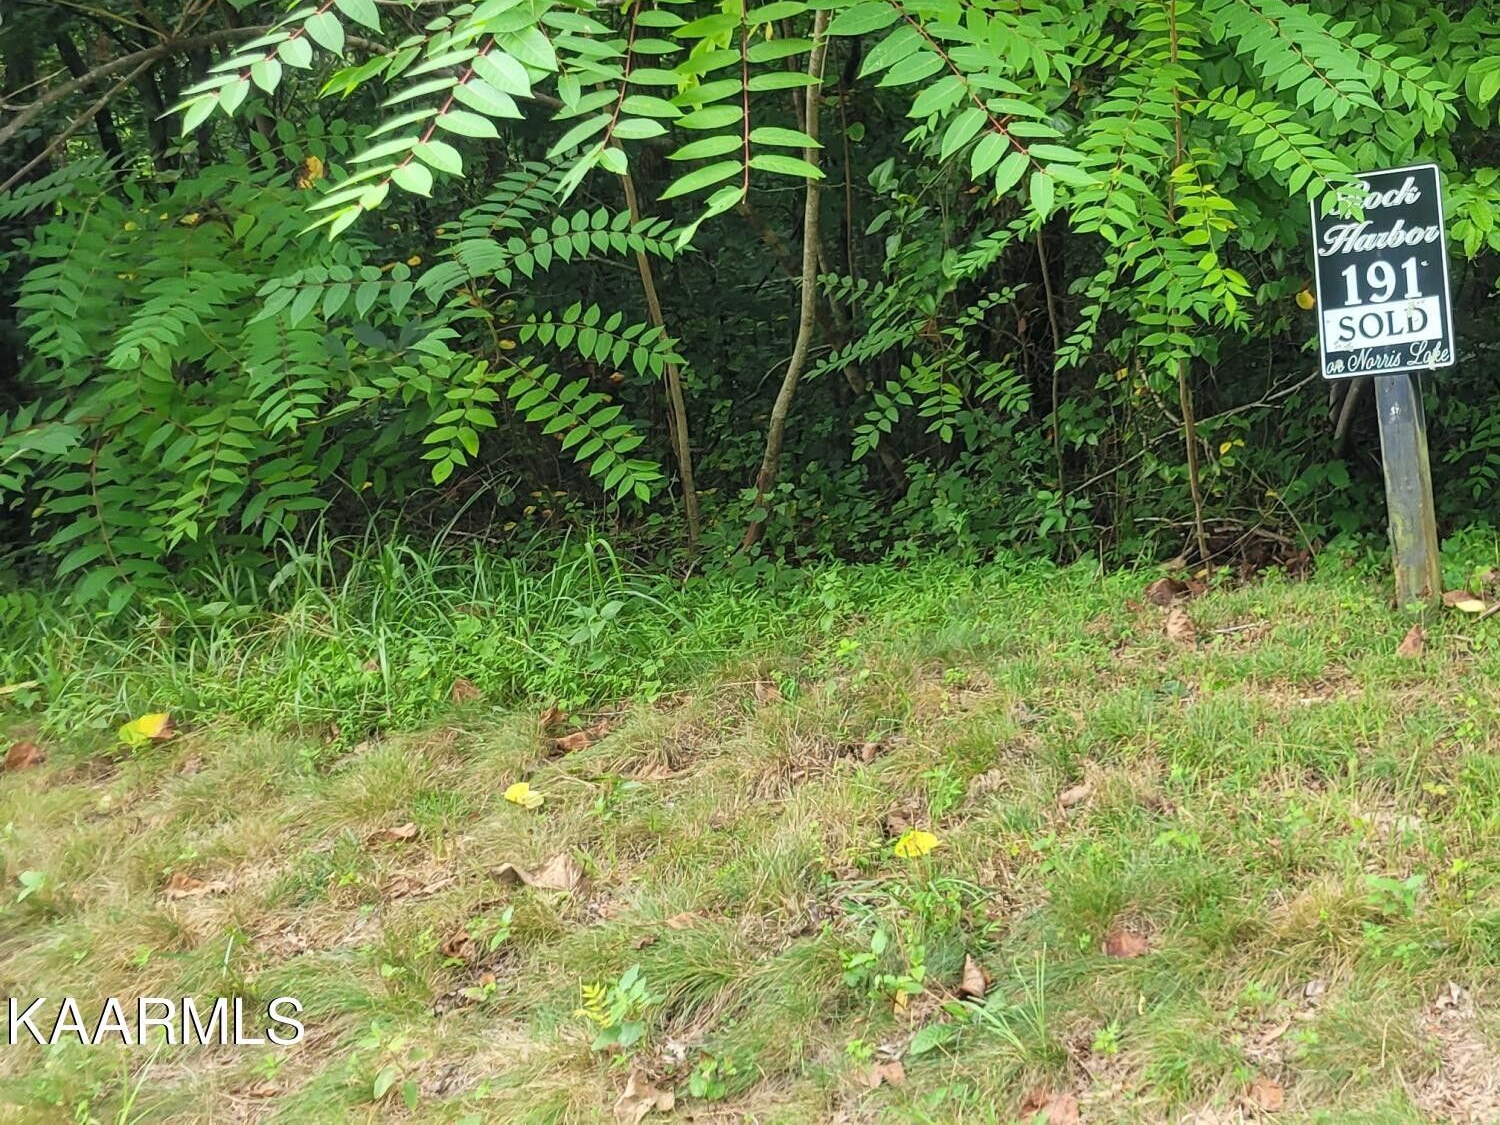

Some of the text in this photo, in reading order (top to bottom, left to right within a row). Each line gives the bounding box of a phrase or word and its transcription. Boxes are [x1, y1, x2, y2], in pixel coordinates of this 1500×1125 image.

[1328, 177, 1421, 219] ock
[1318, 219, 1440, 257] Harbor
[1341, 256, 1423, 306] 191
[1338, 307, 1428, 342] SOLD
[1347, 348, 1401, 371] Norris
[1406, 340, 1449, 367] Lake
